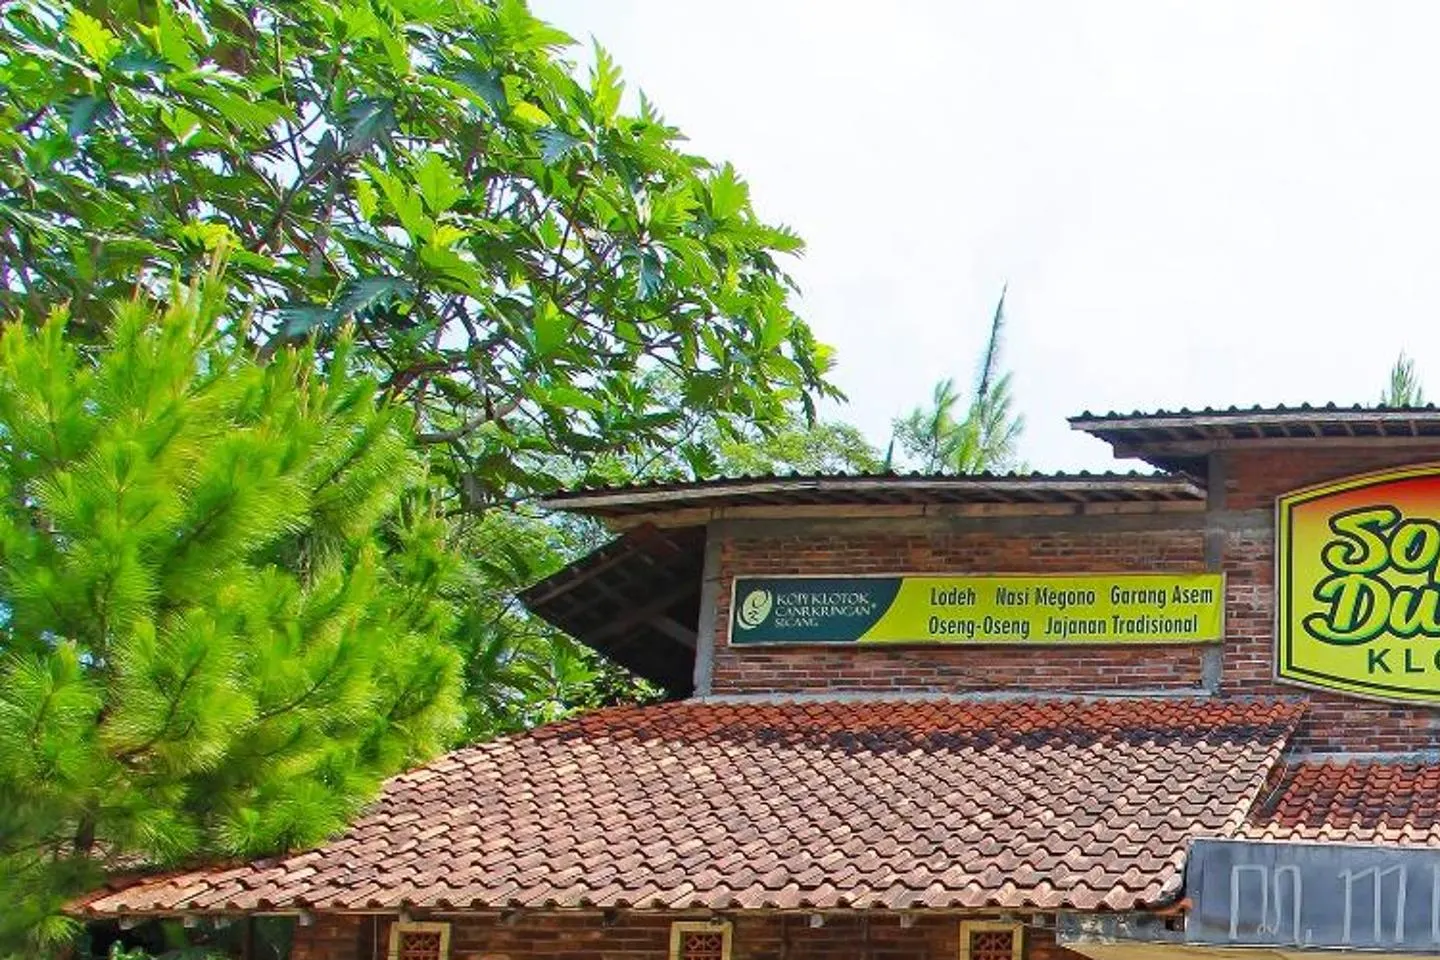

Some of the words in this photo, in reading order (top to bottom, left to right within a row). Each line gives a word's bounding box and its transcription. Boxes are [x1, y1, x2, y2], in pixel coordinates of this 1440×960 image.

[811, 592, 870, 605] KLOTOK
[930, 587, 976, 606] Lodeh
[995, 587, 1029, 606] Nasi
[1034, 586, 1096, 610] Megono
[1110, 585, 1167, 609] Garang
[1171, 585, 1213, 604] Asem
[928, 615, 1030, 639] Oseng-Oseng
[1045, 615, 1107, 639] Jajanan
[1112, 614, 1198, 635] Tradisional
